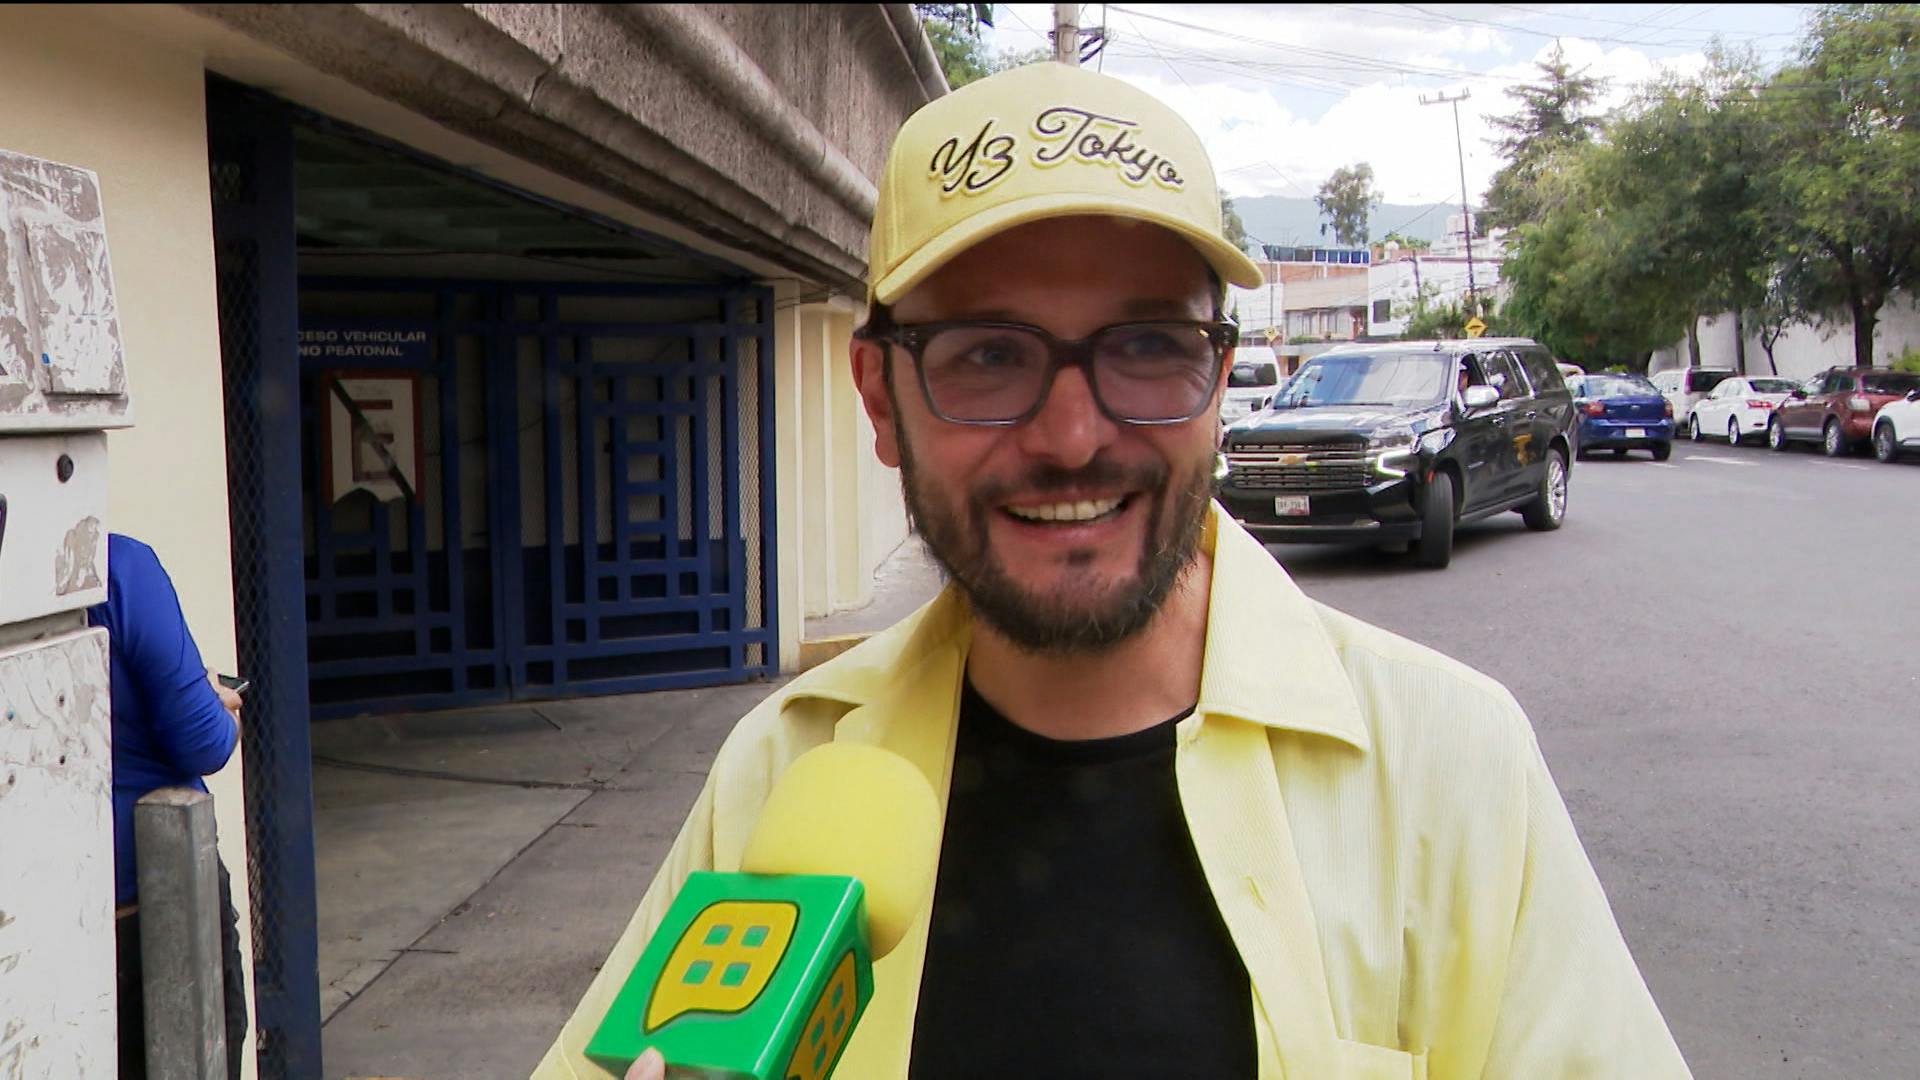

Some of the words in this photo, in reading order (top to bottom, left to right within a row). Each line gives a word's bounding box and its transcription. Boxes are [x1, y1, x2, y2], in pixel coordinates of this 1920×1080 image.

[1036, 107, 1185, 184] Tokyo
[343, 331, 427, 343] VEHICULAR
[298, 345, 321, 356] NO
[326, 345, 405, 356] PEATONAL
